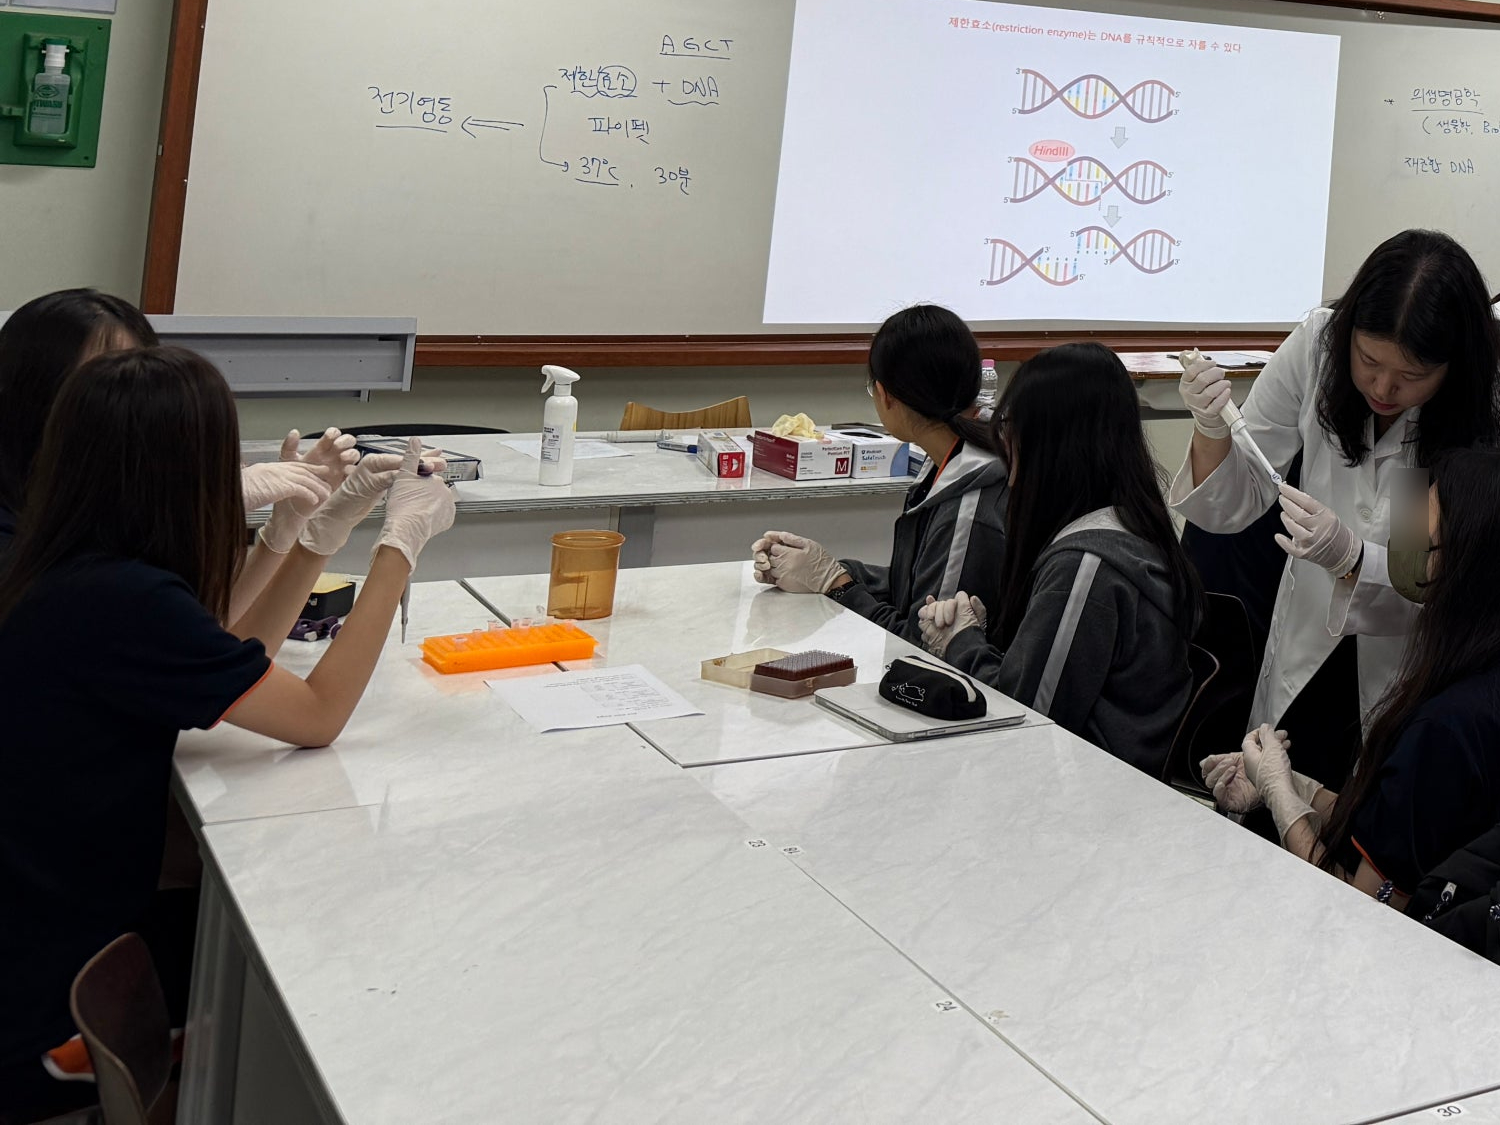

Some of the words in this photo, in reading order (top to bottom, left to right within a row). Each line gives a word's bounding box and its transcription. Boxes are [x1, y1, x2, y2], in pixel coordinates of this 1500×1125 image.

[949, 17, 1044, 35] 제한효소(restriction
[1047, 27, 1096, 42] enzyme)는
[1101, 32, 1132, 44] DNA를
[1136, 34, 1185, 49] 규칙적으로
[1188, 40, 1208, 51] 자를
[1210, 41, 1219, 52] 수
[1224, 42, 1242, 53] 있다
[682, 78, 720, 98] DNA
[1410, 87, 1481, 107] 의생명공학
[367, 86, 452, 125] 전기영동
[588, 117, 650, 144] 파이펫
[1033, 145, 1069, 156] HindIII
[1404, 156, 1441, 174] 재조합
[1450, 159, 1475, 174] DNA
[654, 166, 692, 195] 30분
[836, 459, 848, 472] M
[936, 1001, 957, 1011] 24
[1437, 1105, 1462, 1117] 30
